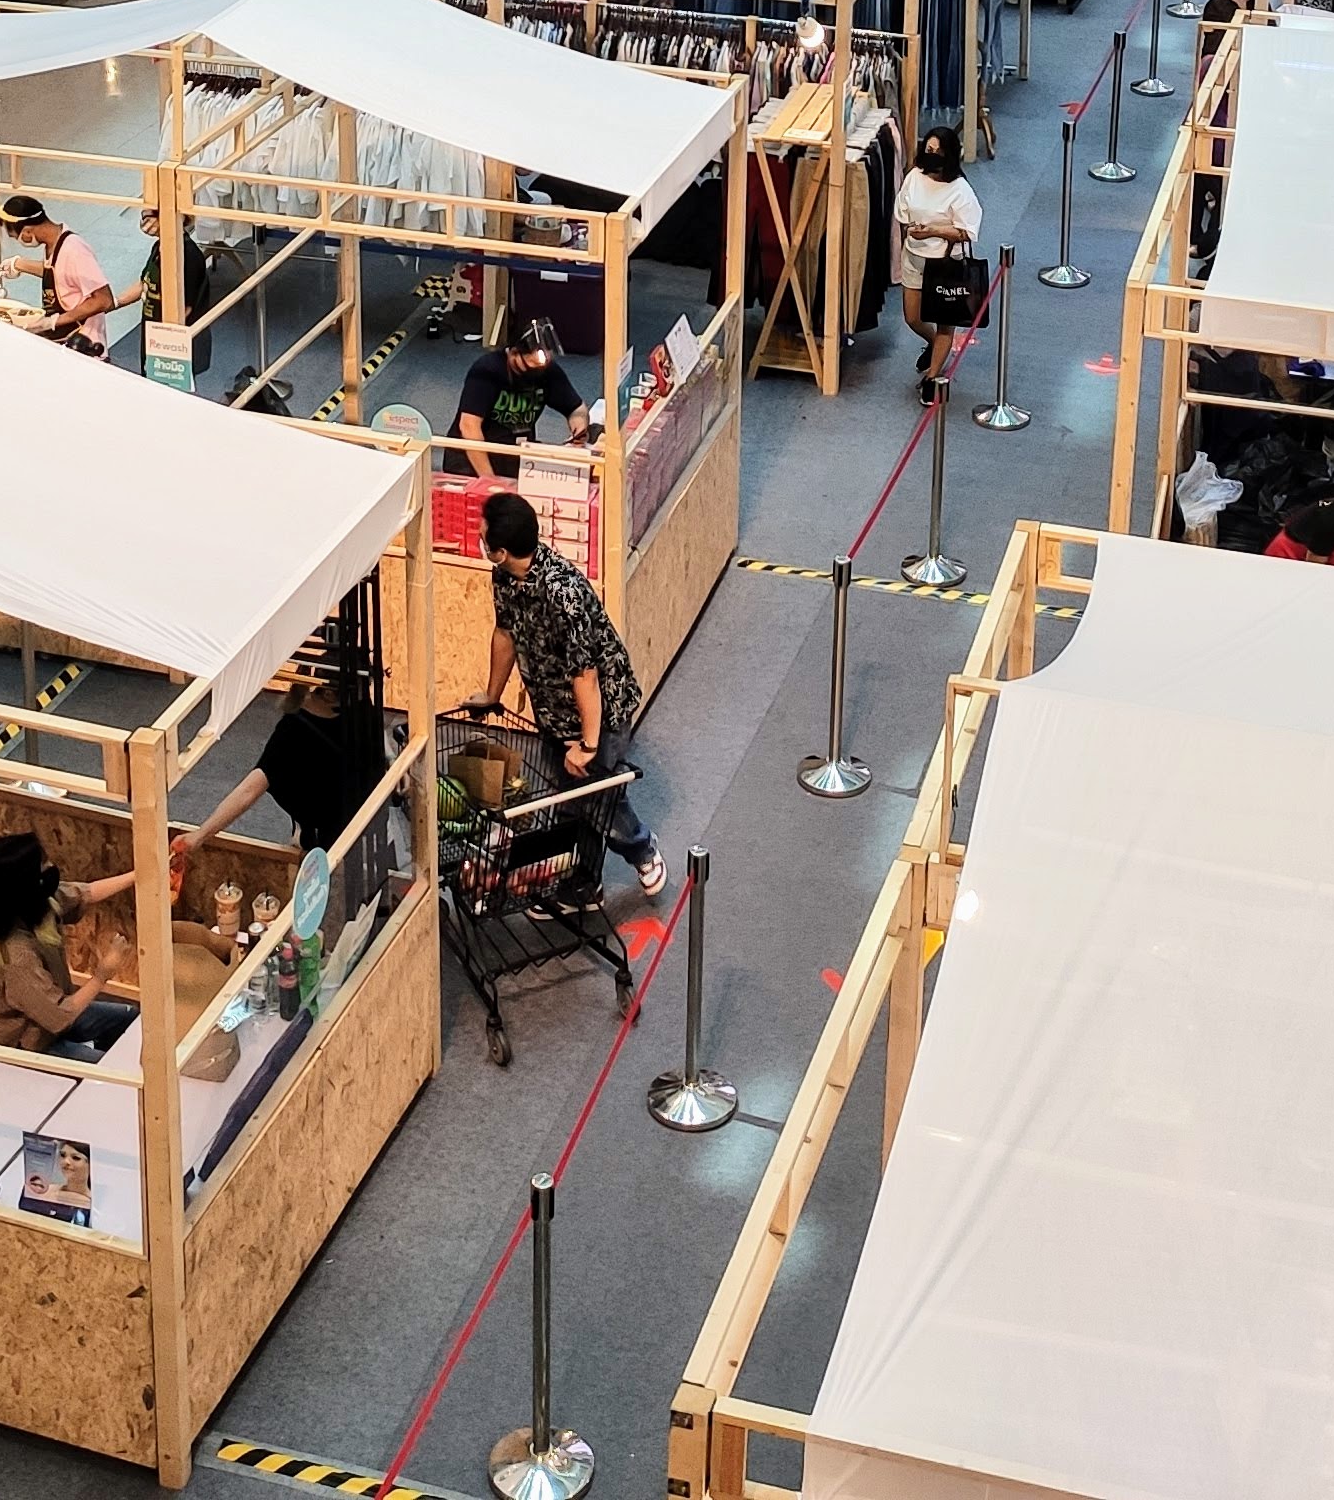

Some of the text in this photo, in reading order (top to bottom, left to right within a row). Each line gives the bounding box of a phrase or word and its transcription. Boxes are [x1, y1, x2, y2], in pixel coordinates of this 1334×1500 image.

[149, 338, 188, 354] Rewash
[525, 460, 536, 479] 2
[575, 466, 583, 484] 1
